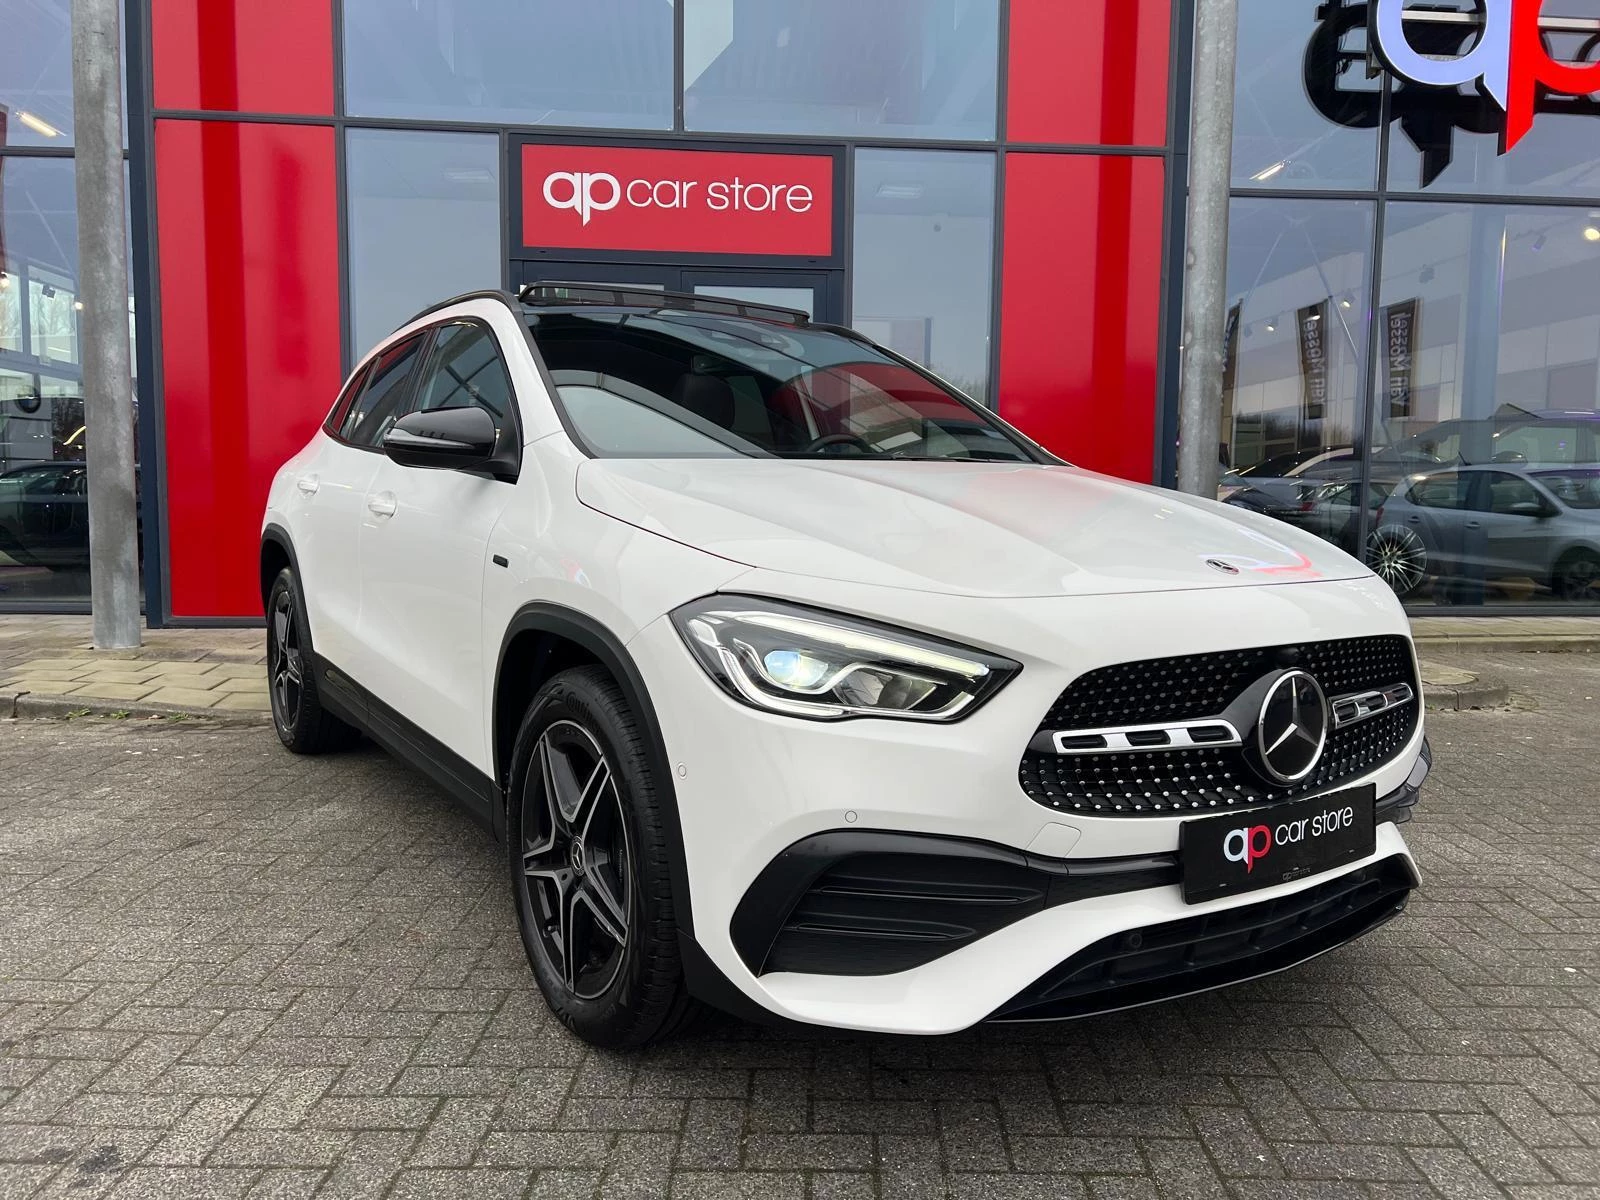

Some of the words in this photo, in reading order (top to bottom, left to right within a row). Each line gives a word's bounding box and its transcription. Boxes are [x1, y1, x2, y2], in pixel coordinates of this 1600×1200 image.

[542, 171, 621, 227] ap
[626, 179, 698, 209] car
[706, 176, 813, 213] store
[1223, 825, 1272, 874] ap
[1275, 818, 1309, 845] car
[1311, 806, 1354, 836] store
